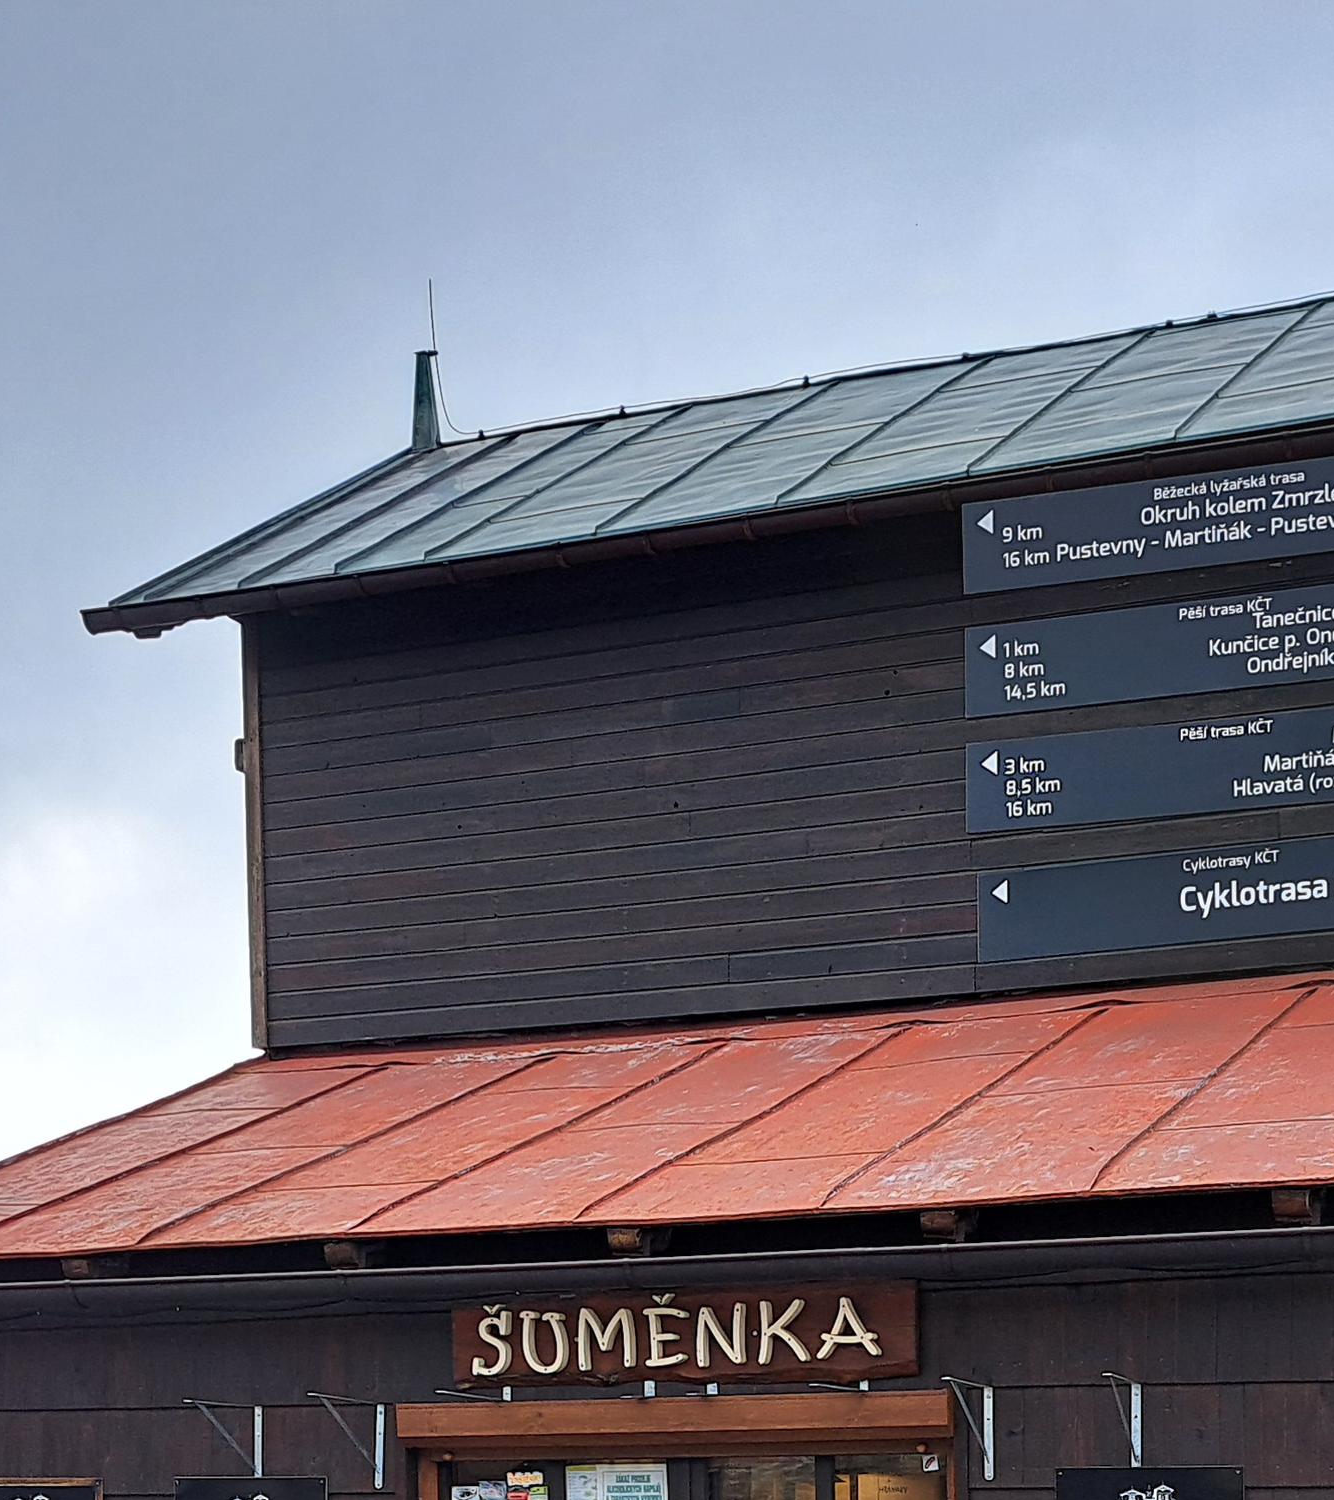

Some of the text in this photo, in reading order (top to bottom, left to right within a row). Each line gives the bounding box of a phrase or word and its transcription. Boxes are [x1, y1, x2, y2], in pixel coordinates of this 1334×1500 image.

[1153, 472, 1306, 500] Běžecká lyžařská trasa
[1141, 498, 1200, 525] Okruh
[1205, 496, 1267, 518] kolem
[1002, 525, 1043, 544] 9 km
[1056, 537, 1146, 563] Pustevny
[1164, 521, 1252, 550] Martiňák
[1002, 549, 1050, 568] 16 km
[1178, 596, 1273, 621] Pěší trasa KČT
[1003, 639, 1039, 658] 1 km
[1209, 635, 1280, 656] Kunčice
[1284, 634, 1300, 654] p.
[1004, 660, 1044, 679] 8 km
[1004, 680, 1066, 701] 14,5 km
[1180, 717, 1274, 741] Pěší trasa KČT
[1004, 756, 1045, 775] 3 km
[1006, 776, 1061, 798] 8,5 km
[1233, 775, 1305, 797] Hlavatá
[1006, 798, 1052, 818] 16 km
[1183, 847, 1280, 874] Cyklotrasy KČT
[1179, 877, 1329, 919] Cyklotrasa
[470, 1293, 884, 1377] ŠUMĚNKA
